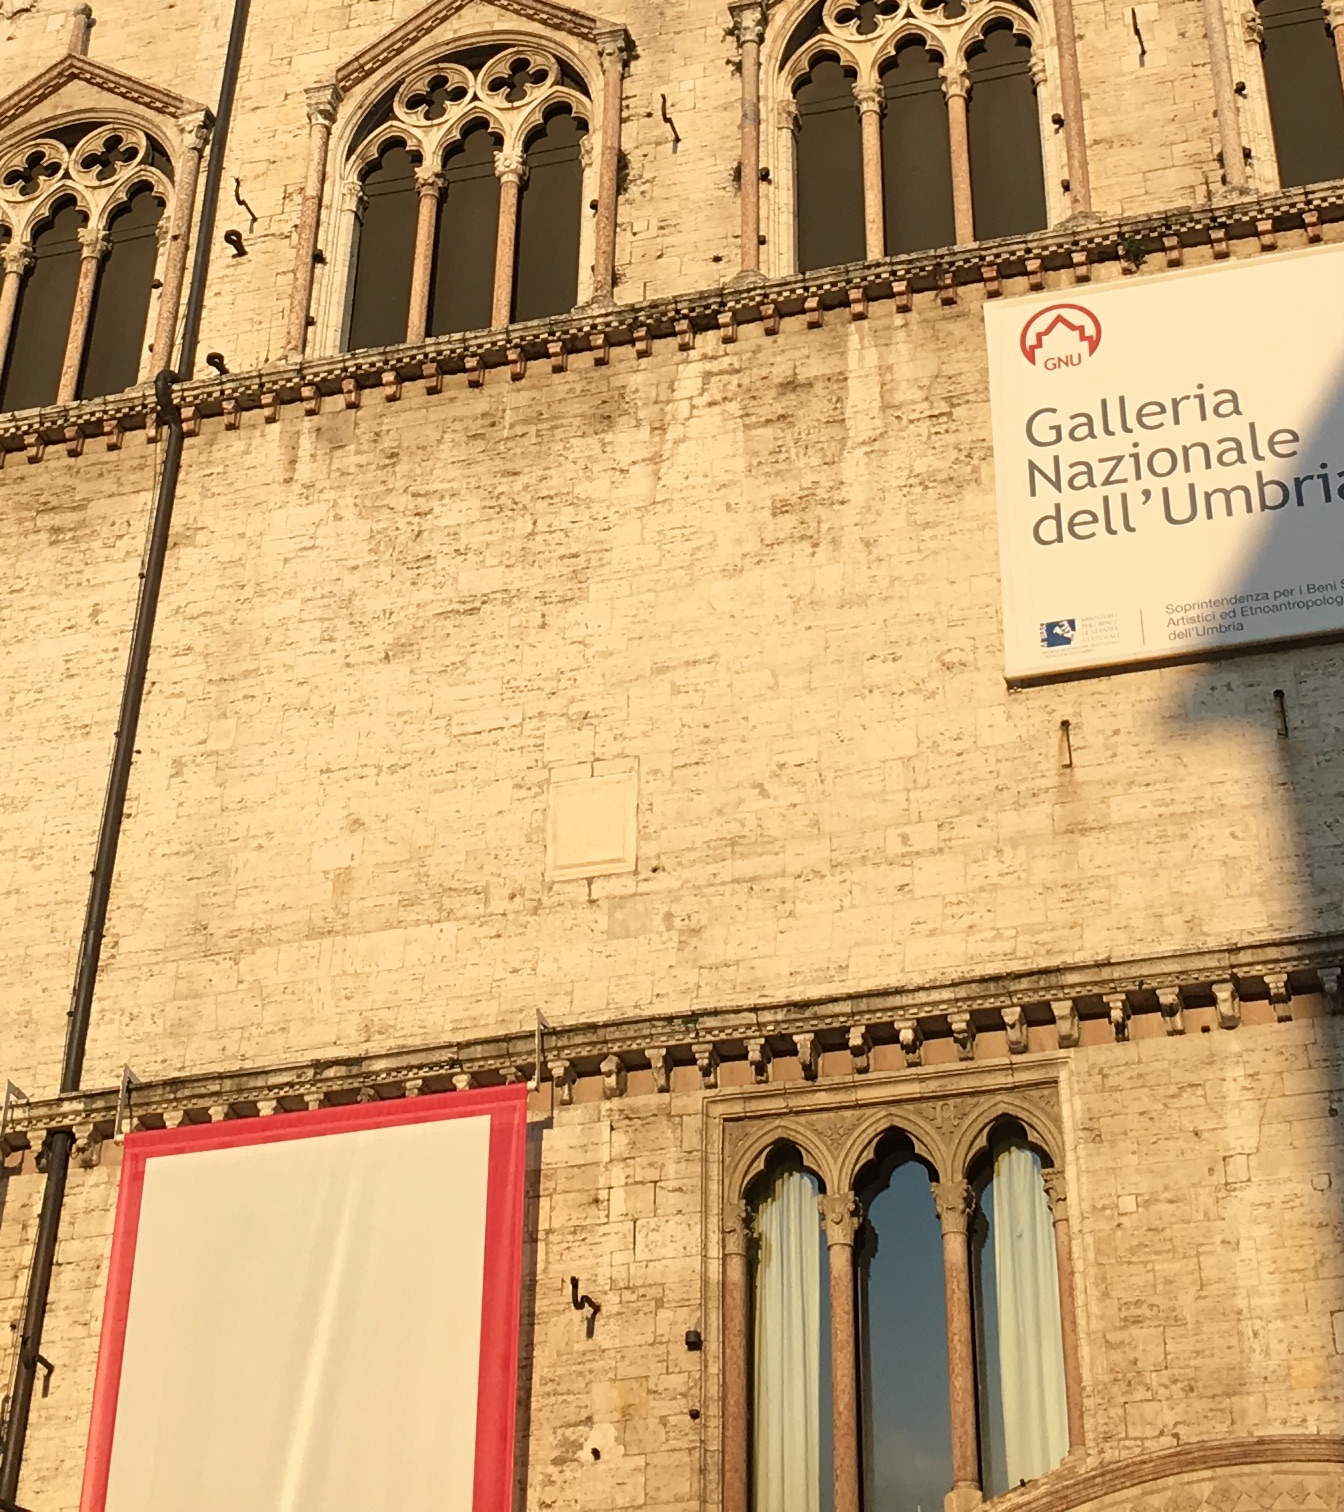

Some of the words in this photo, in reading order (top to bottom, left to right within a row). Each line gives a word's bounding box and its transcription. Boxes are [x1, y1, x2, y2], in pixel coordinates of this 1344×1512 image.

[1044, 352, 1082, 371] GNU
[1025, 383, 1243, 447] Galleria
[1027, 421, 1300, 497] Nazionale
[1165, 591, 1270, 615] Soprintendenza
[1273, 587, 1296, 601] per
[1306, 580, 1338, 595] Beni
[1166, 613, 1216, 628] Artistici
[1219, 608, 1237, 620] ed
[1168, 621, 1245, 641] dell'Umbria
